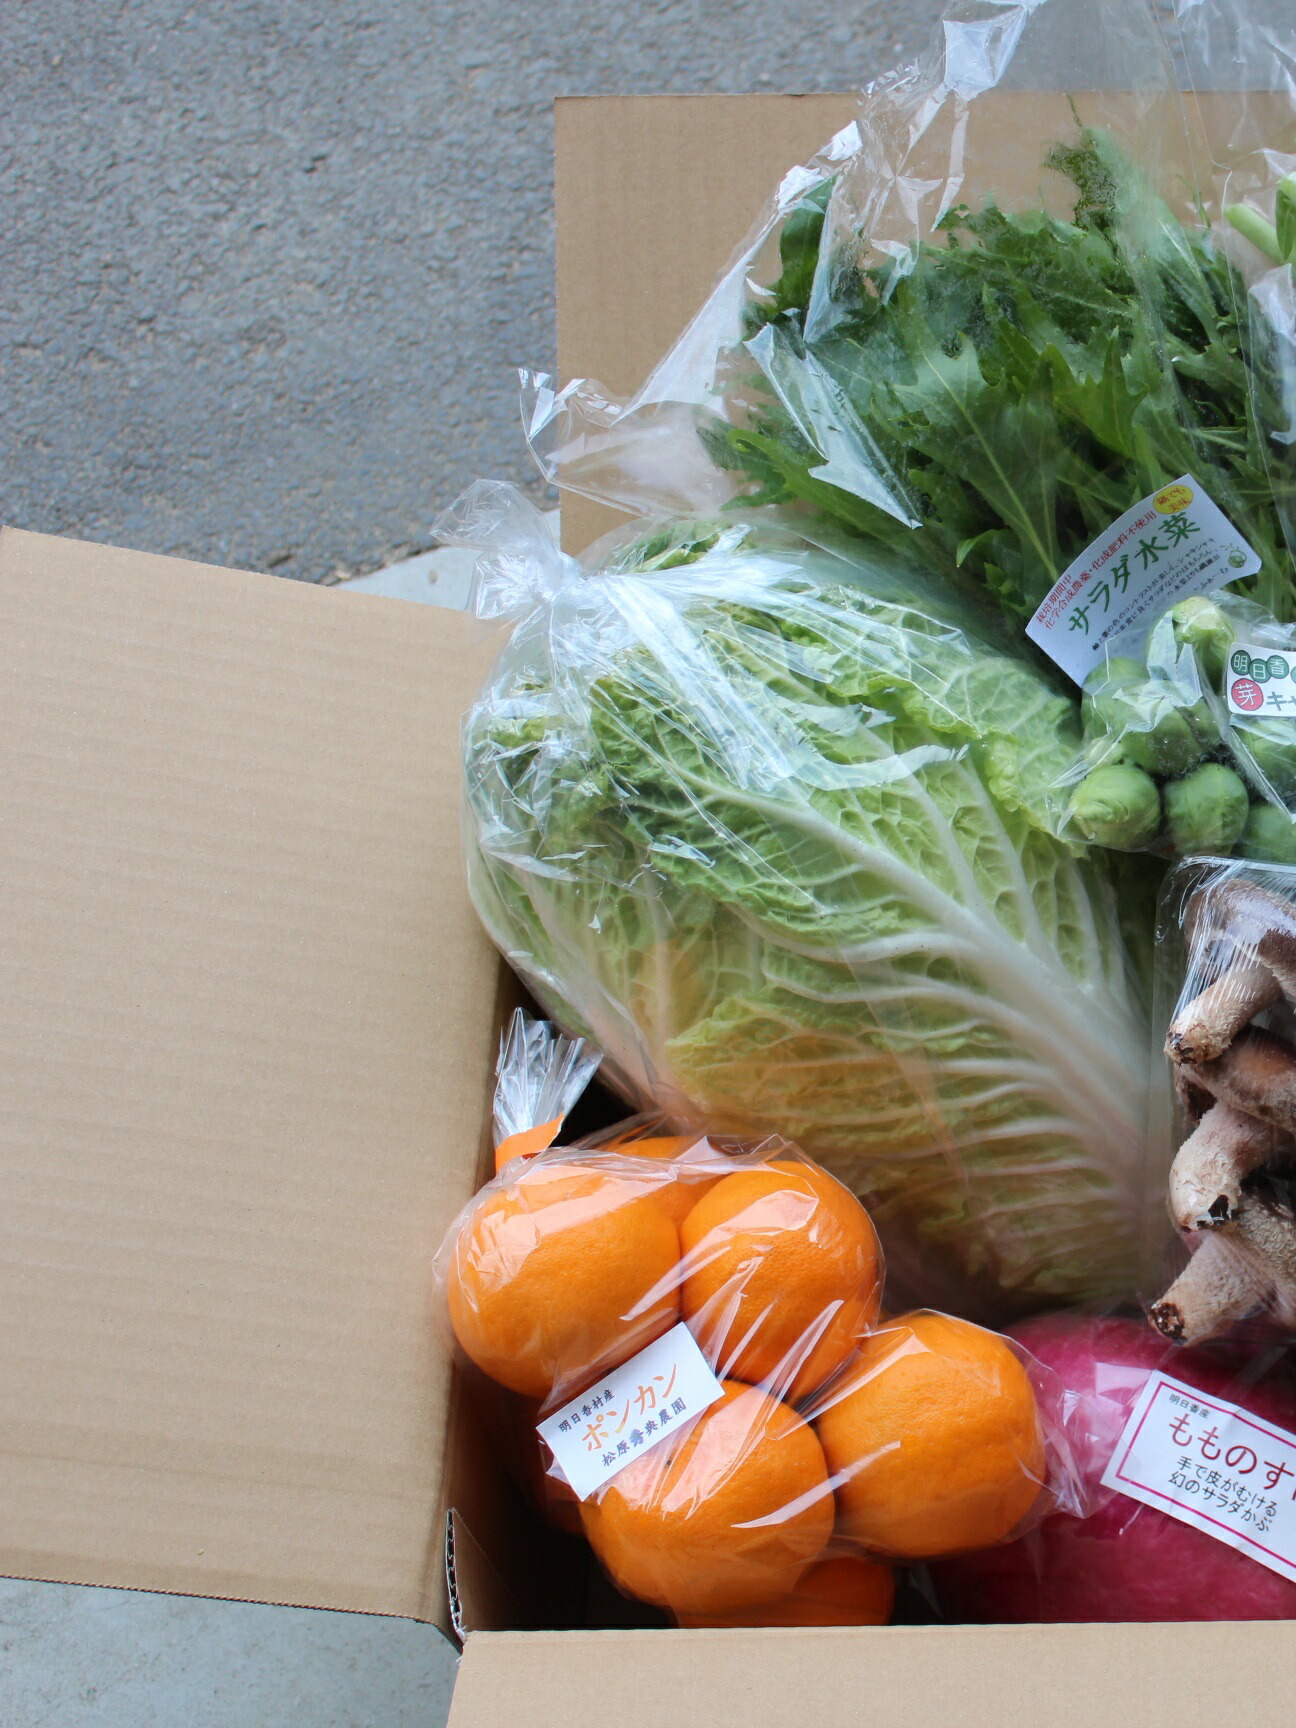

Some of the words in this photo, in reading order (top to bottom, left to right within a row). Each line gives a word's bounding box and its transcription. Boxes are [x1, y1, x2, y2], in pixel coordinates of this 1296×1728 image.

[1036, 574, 1073, 624] 栽培期間中
[1068, 511, 1200, 636] サラダ水菜
[558, 1388, 615, 1432] 明日香村産
[581, 1363, 676, 1451] ポンカン
[1168, 1470, 1273, 1533] 幻のサラダかぶ
[1177, 1455, 1277, 1518] 手で皮がむける
